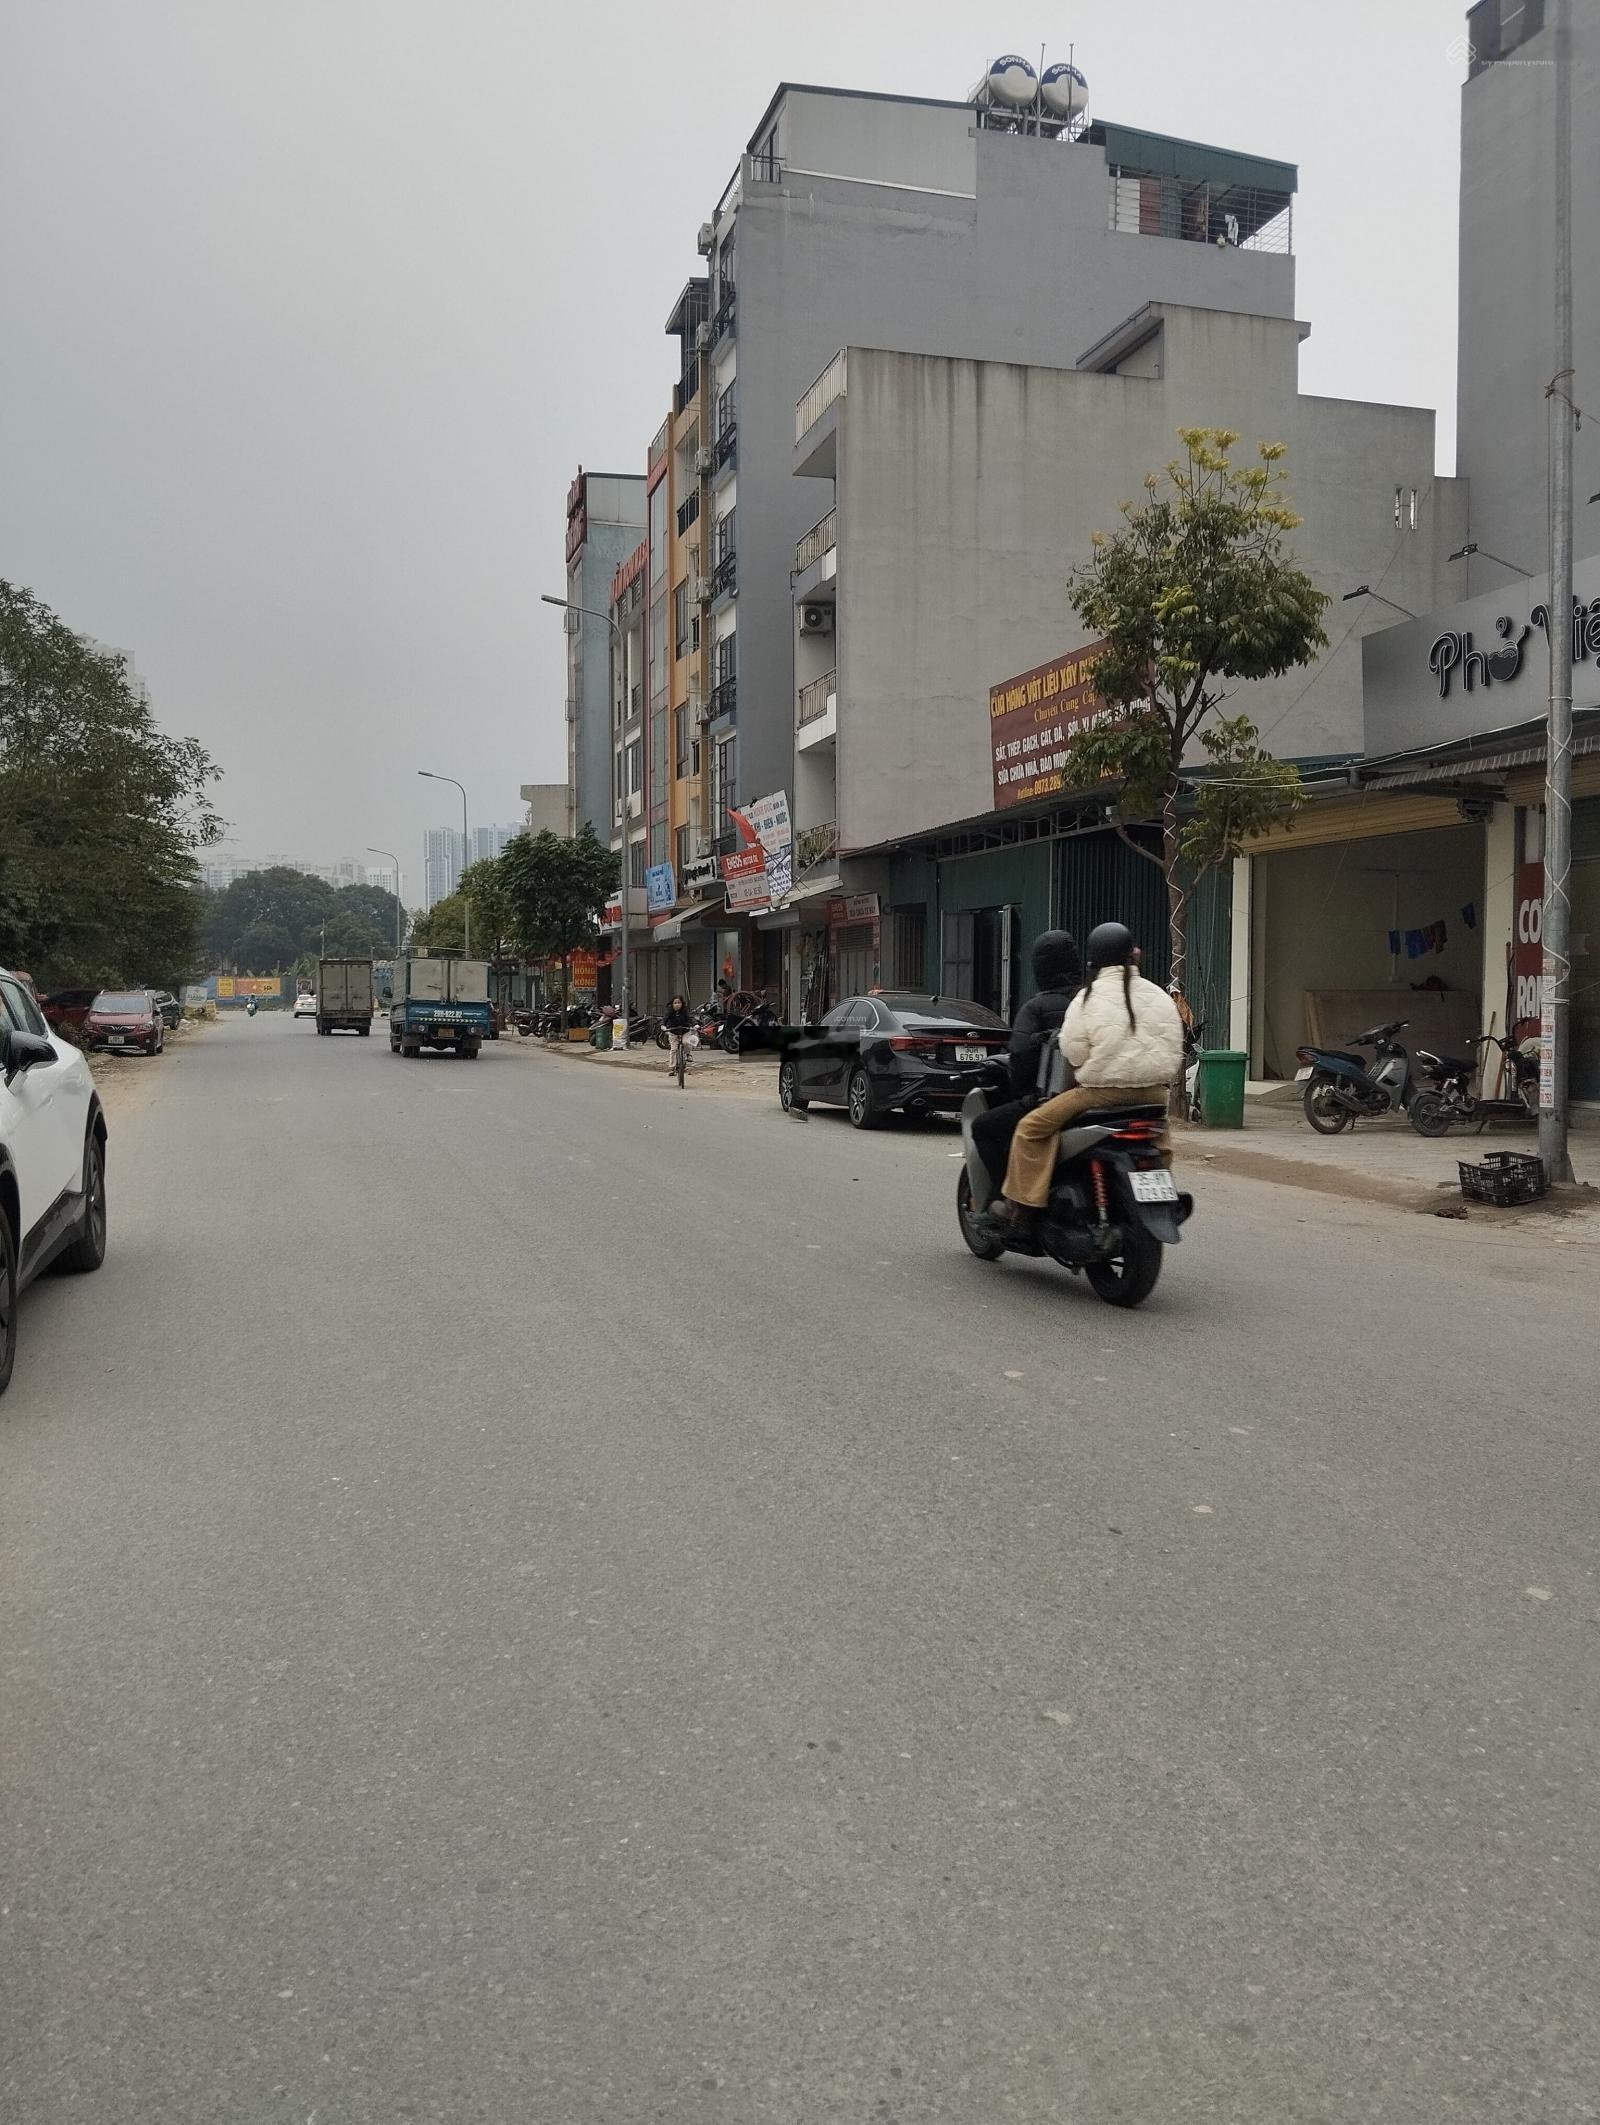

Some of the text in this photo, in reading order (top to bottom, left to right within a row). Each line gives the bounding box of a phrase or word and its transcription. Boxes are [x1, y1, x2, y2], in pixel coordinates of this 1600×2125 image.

[1027, 675, 1042, 708] VẬT
[1043, 668, 1059, 701] LIỆU
[1060, 660, 1077, 692] XÂY
[726, 854, 743, 869] ENEOS
